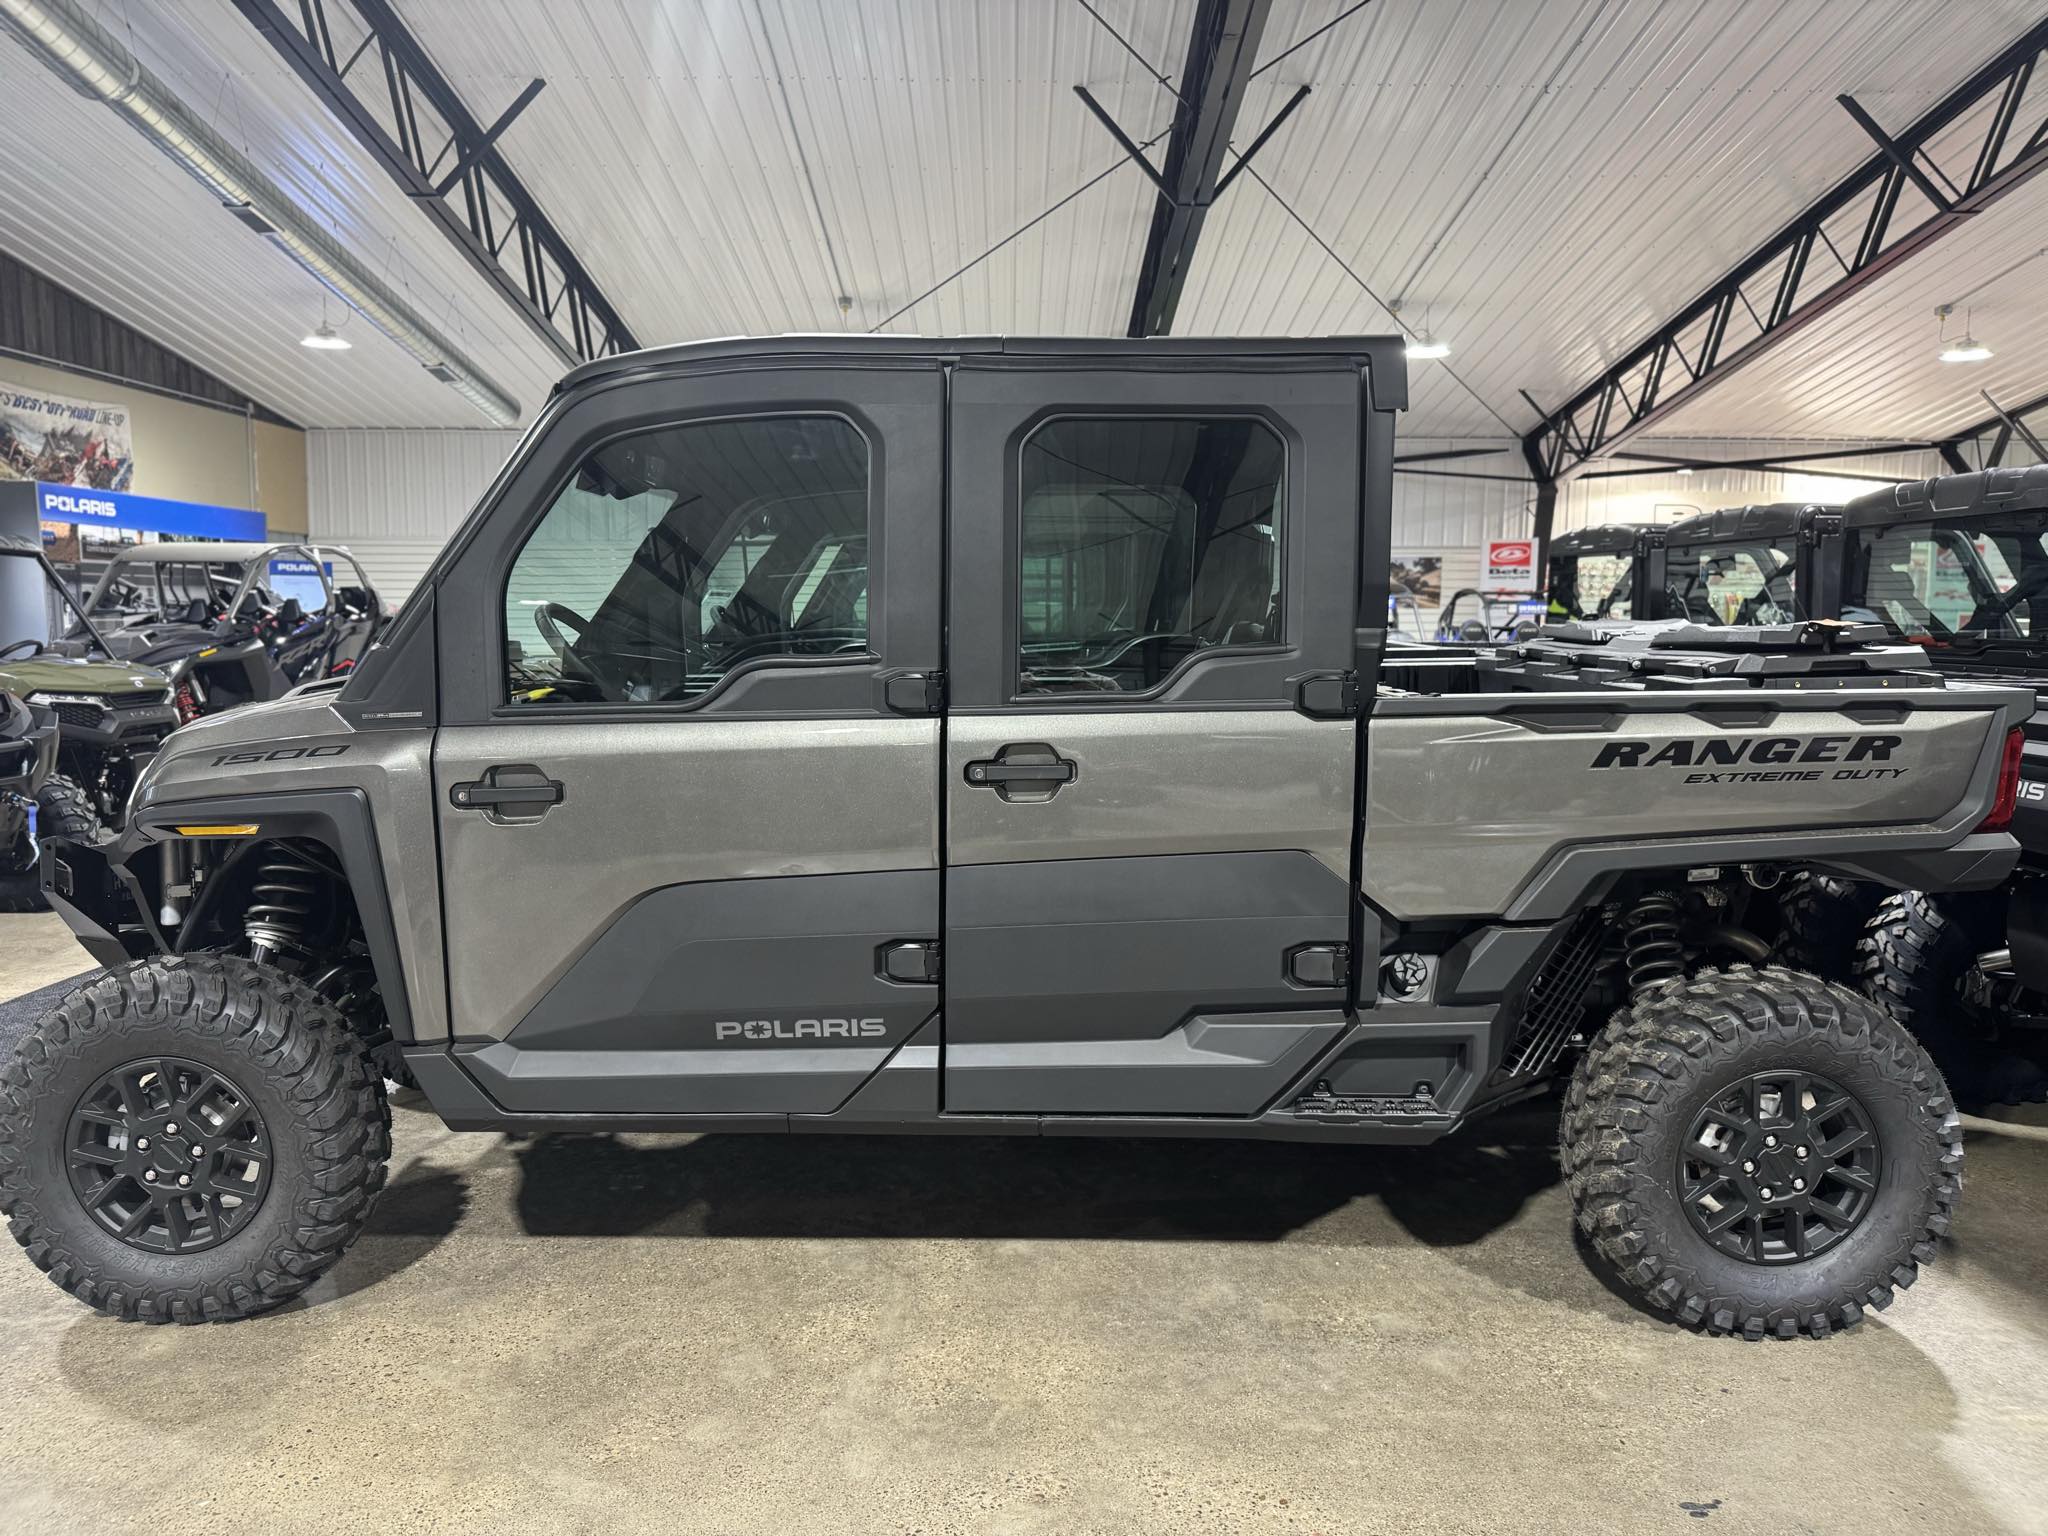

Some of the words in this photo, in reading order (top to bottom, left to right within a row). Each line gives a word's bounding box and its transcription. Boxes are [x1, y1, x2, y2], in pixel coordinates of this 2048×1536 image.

[45, 494, 116, 517] POLARIS
[277, 563, 318, 572] POLAR
[211, 744, 351, 767] 1500
[1590, 735, 1903, 769] RANGER
[1683, 770, 1824, 784] EXTREME
[1832, 768, 1910, 780] DUTY
[715, 1018, 887, 1040] POLARIS
